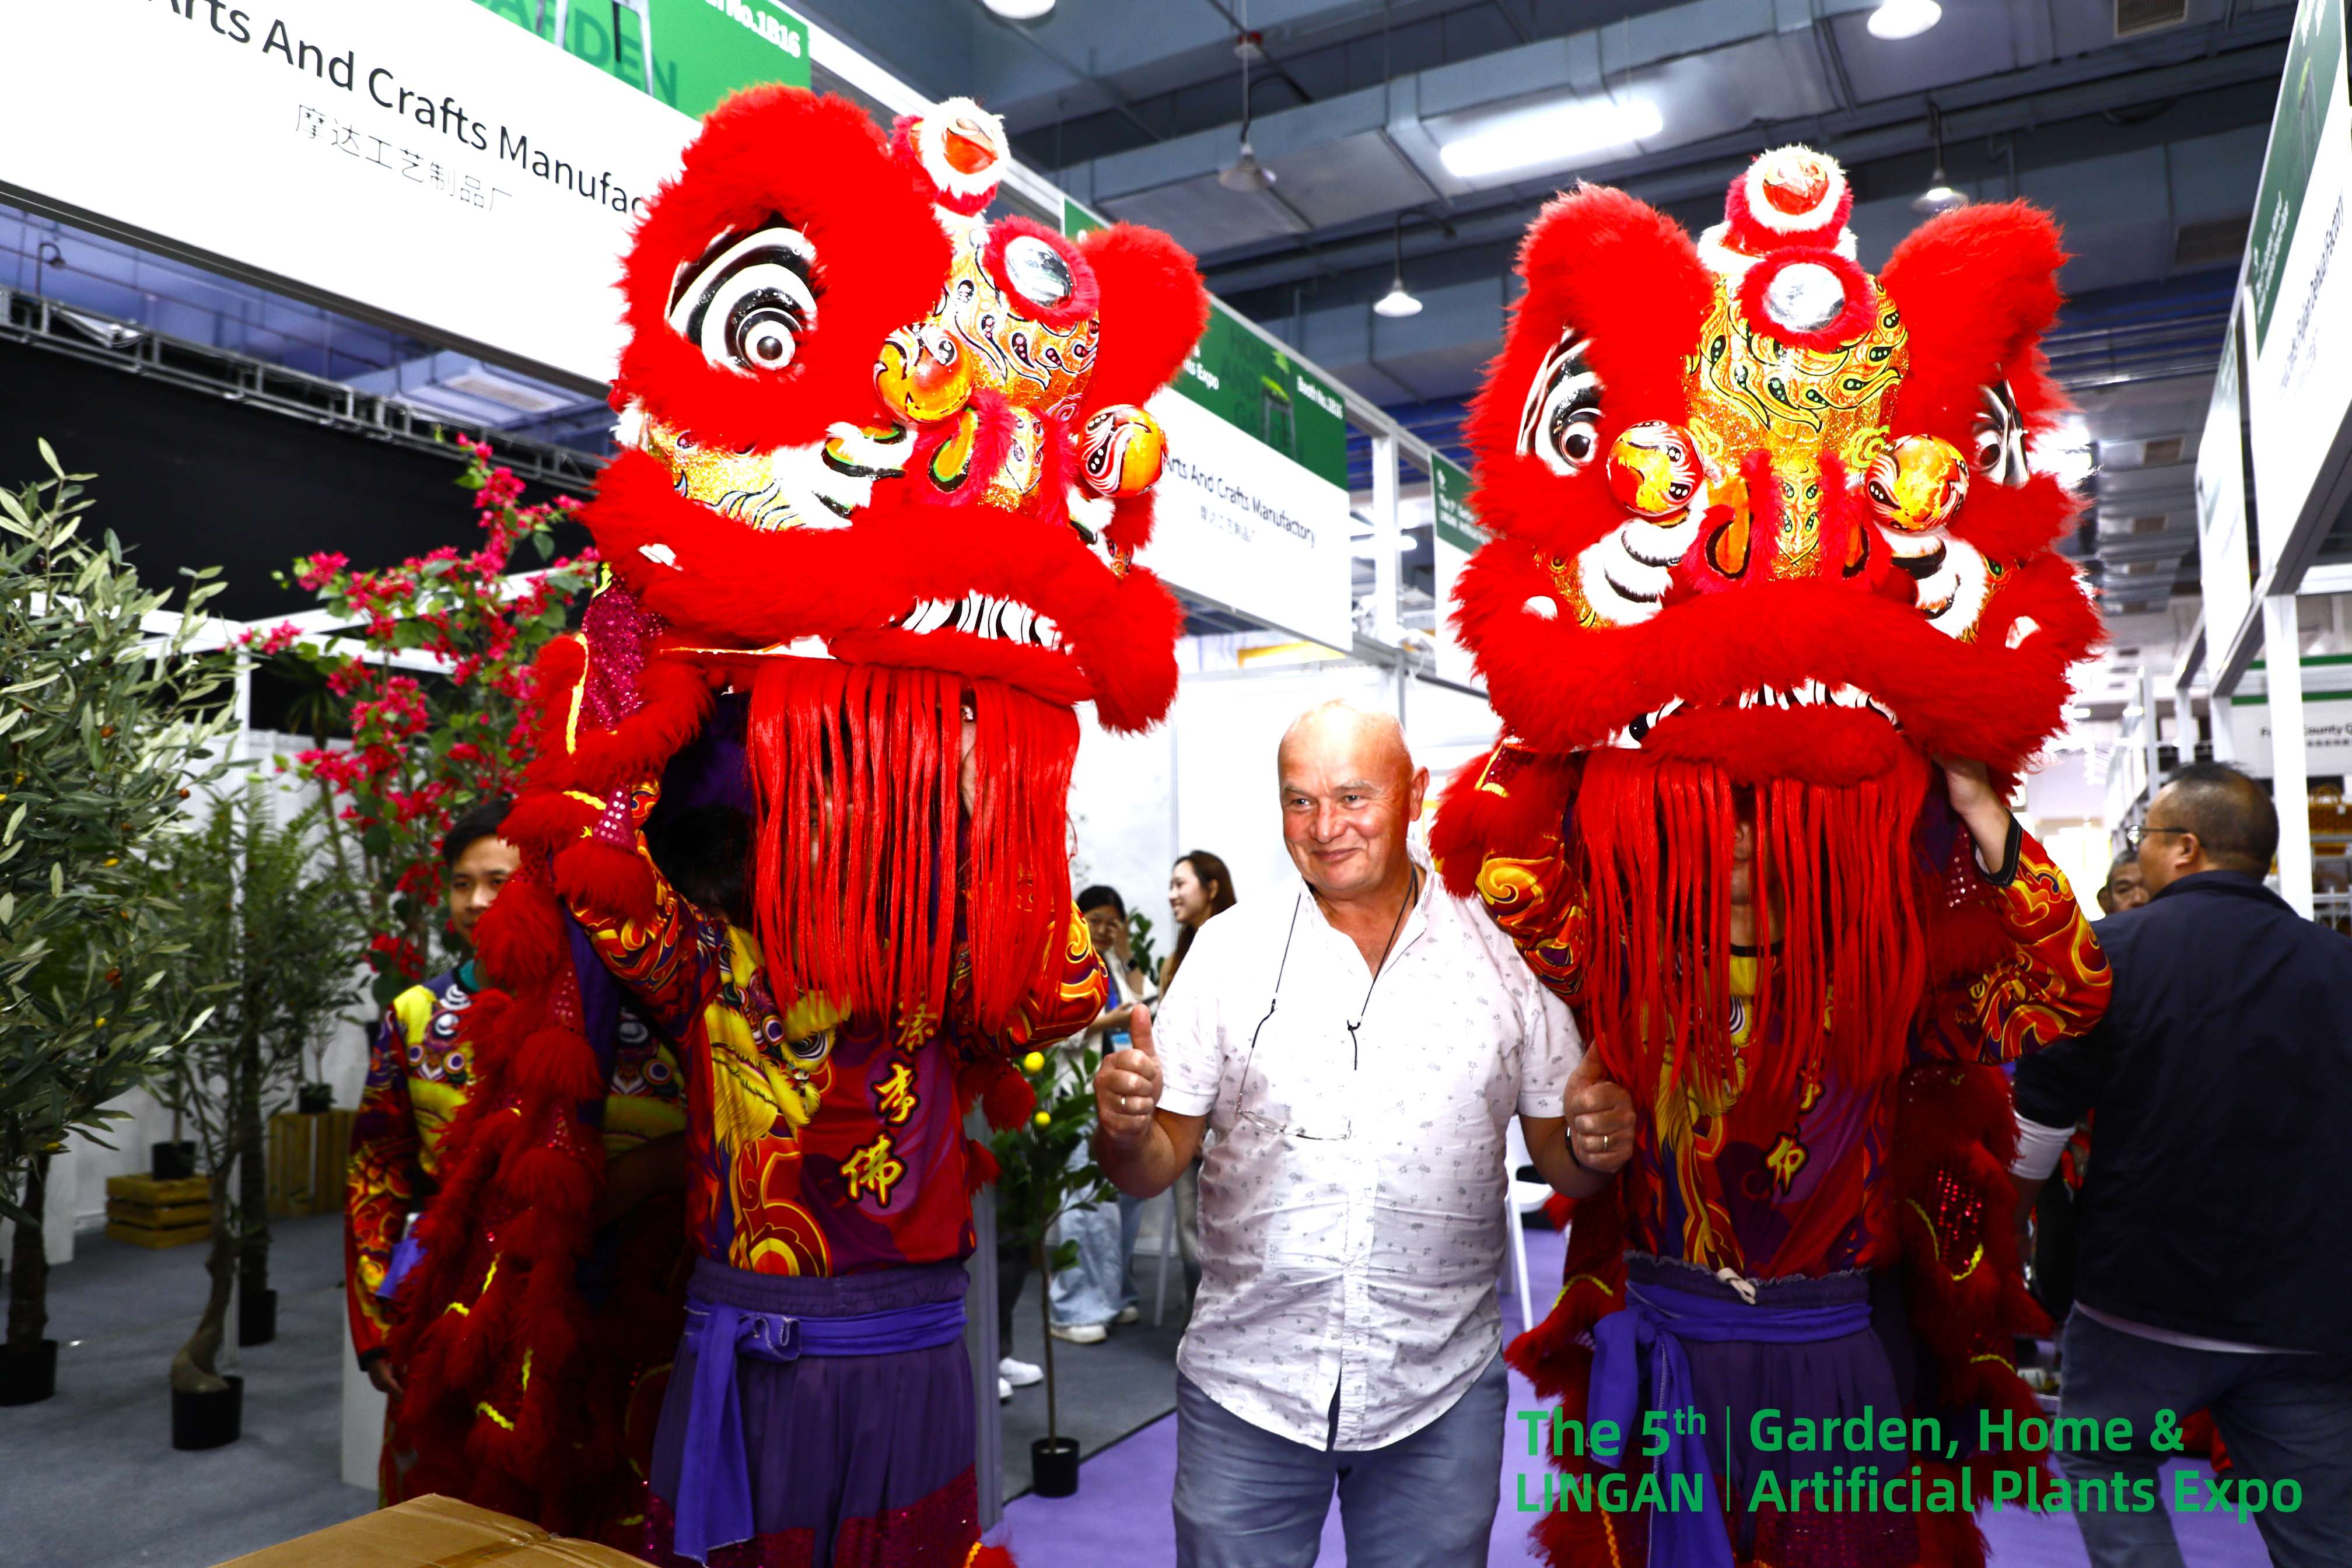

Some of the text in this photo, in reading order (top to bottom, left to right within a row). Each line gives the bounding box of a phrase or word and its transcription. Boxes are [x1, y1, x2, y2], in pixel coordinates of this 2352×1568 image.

[262, 19, 354, 92] And
[368, 68, 487, 150] Crafts
[296, 104, 513, 211] 摩达工艺制品厂
[1196, 362, 1220, 391] Expo
[1191, 464, 1214, 493] And
[1217, 478, 1250, 511] Crafts
[1253, 496, 1316, 549] Manufactory
